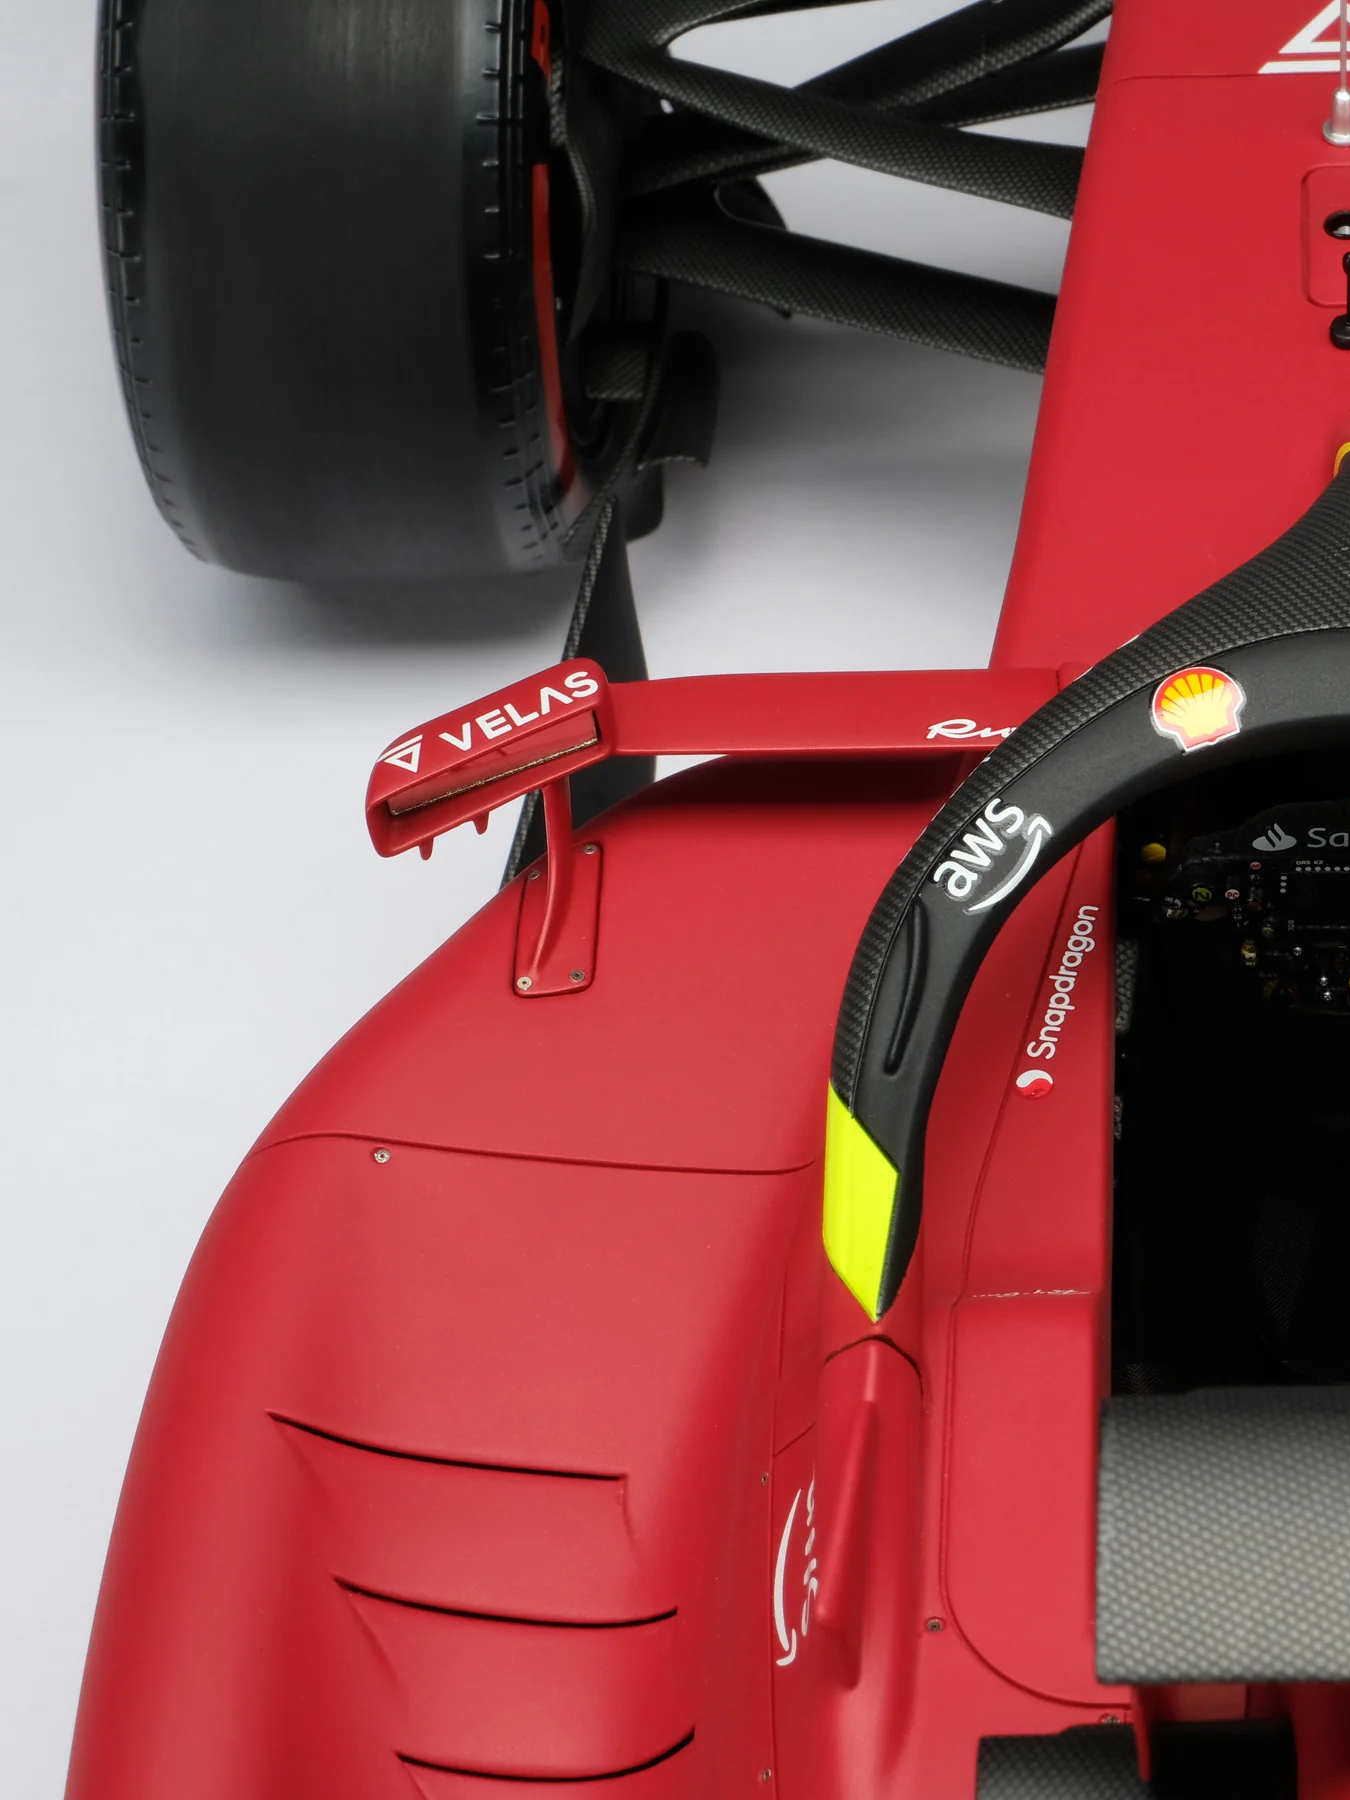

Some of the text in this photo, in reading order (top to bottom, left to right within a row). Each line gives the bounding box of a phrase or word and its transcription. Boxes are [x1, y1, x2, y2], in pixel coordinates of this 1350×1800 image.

[439, 671, 599, 752] VELAS
[933, 797, 1025, 898] aws
[1026, 904, 1100, 1060] Snapdragon
